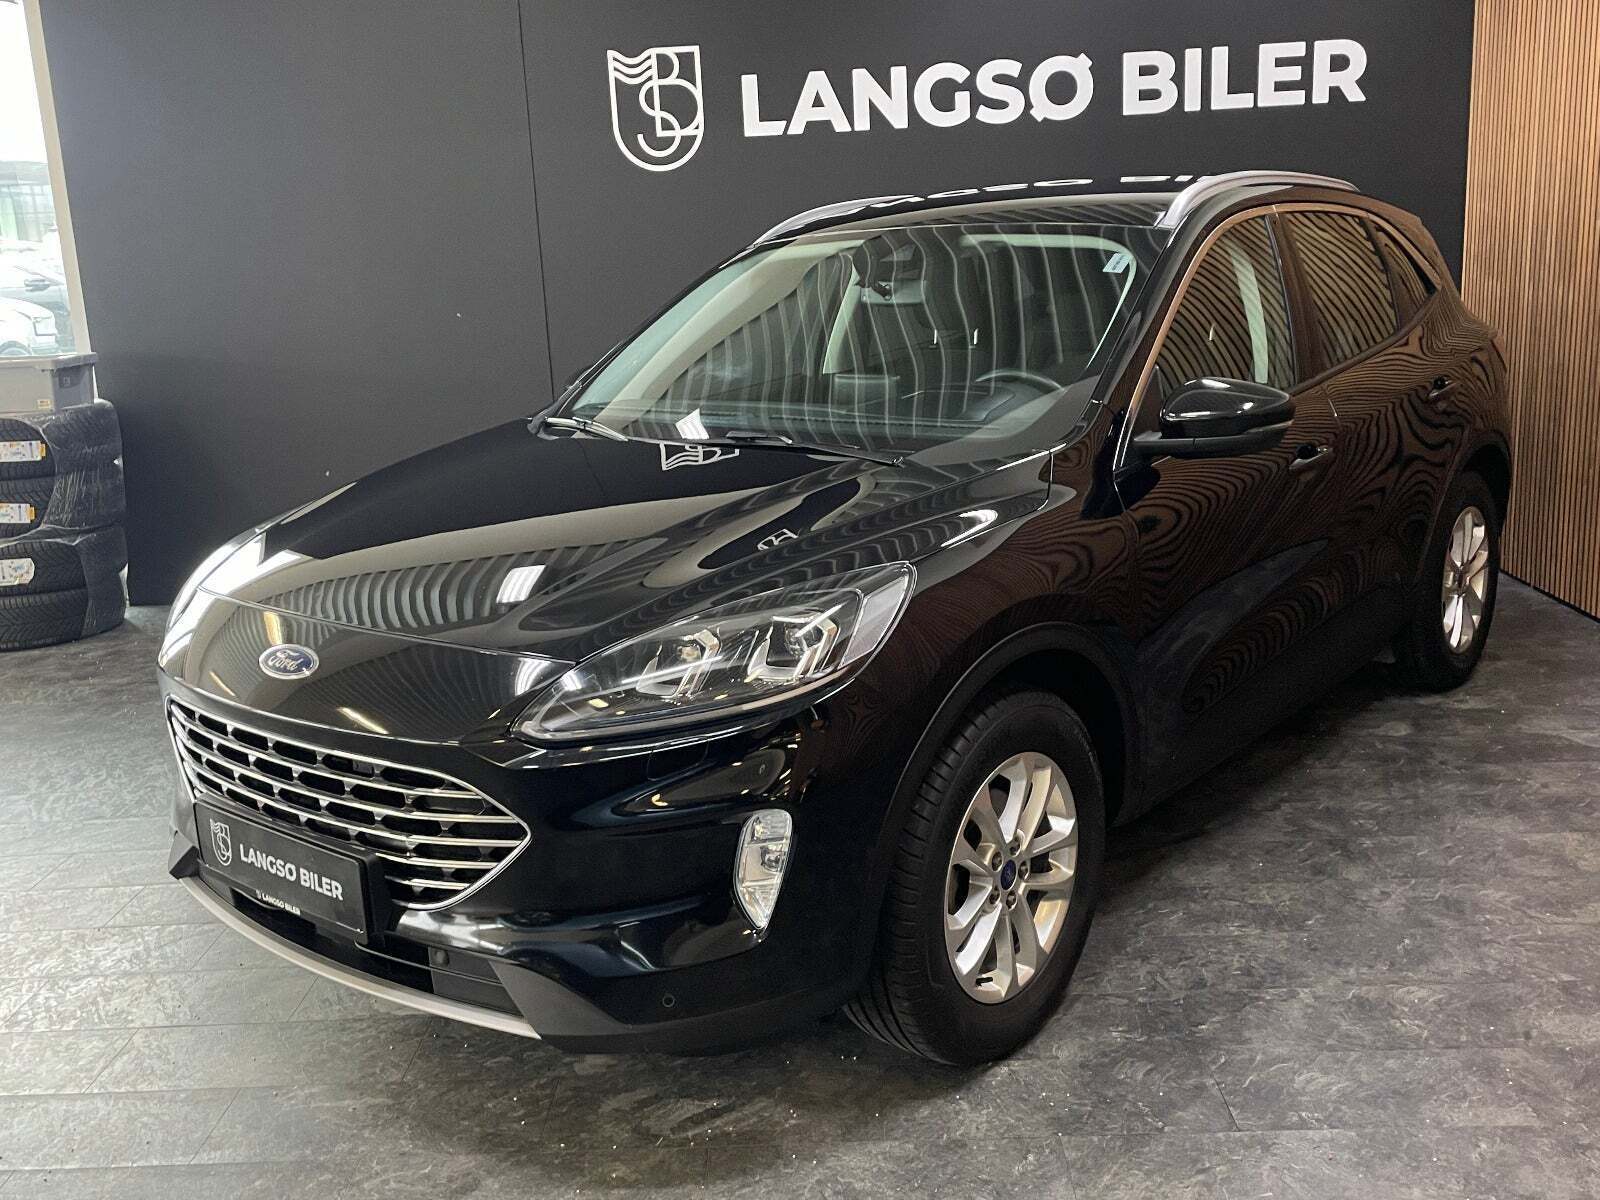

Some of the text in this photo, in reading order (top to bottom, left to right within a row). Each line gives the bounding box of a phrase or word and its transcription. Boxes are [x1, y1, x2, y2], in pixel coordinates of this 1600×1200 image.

[740, 38, 1368, 138] LANGSØ BILER
[299, 867, 344, 901] BILER
